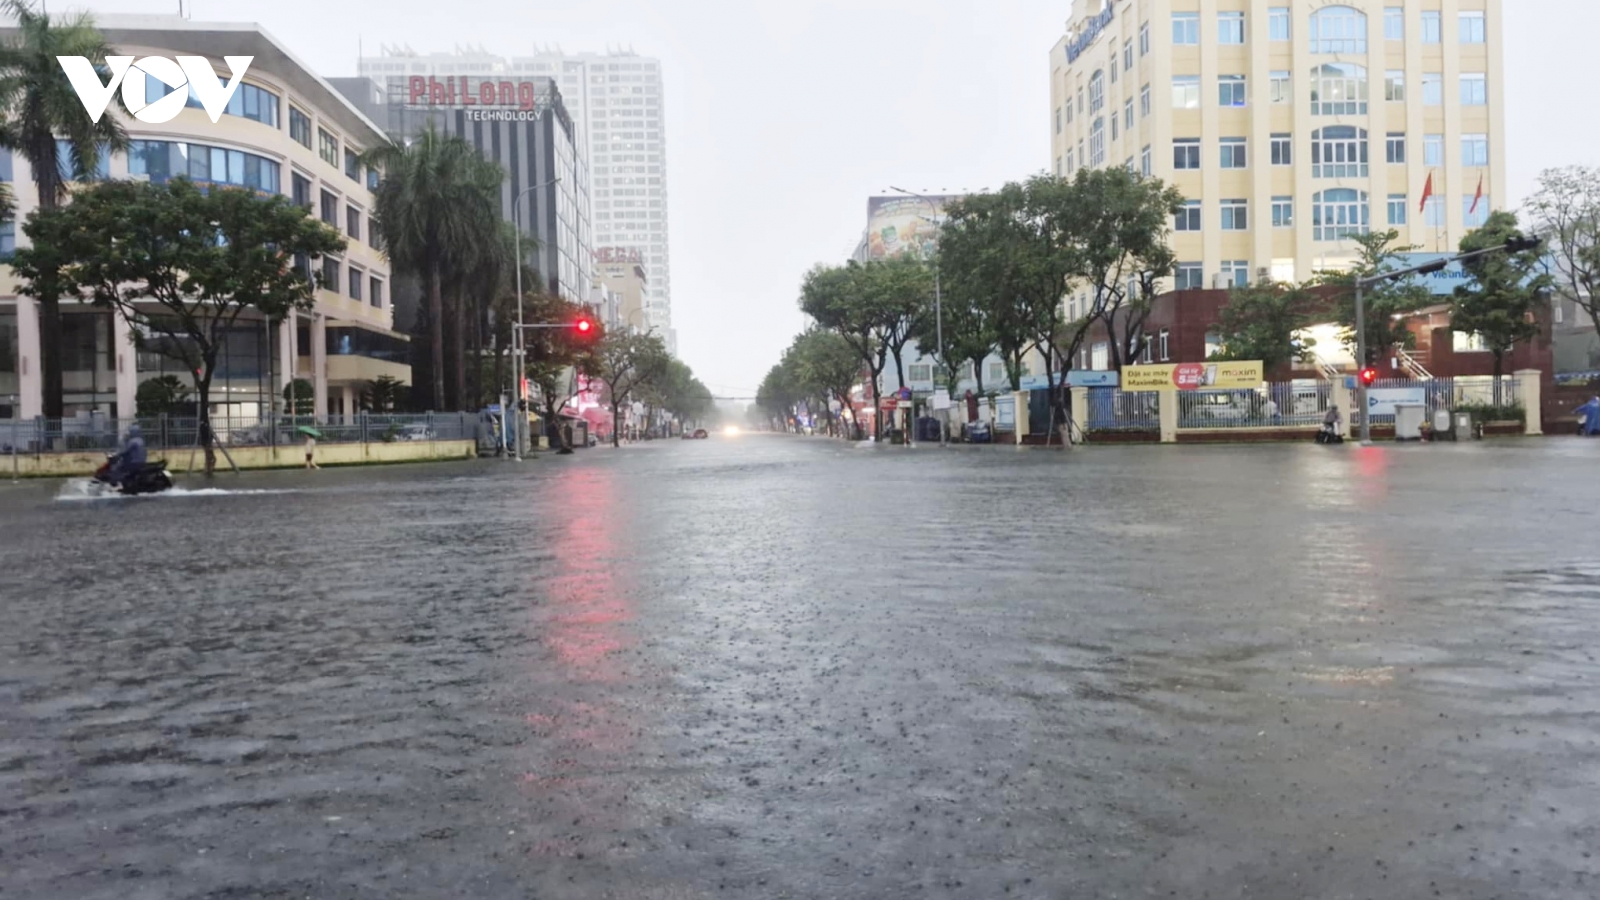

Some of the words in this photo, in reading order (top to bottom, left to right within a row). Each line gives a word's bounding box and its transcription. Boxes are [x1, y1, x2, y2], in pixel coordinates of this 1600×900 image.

[408, 75, 535, 111] PhiLong
[466, 110, 542, 122] TECHNOLOGY
[1222, 367, 1257, 376] maxim
